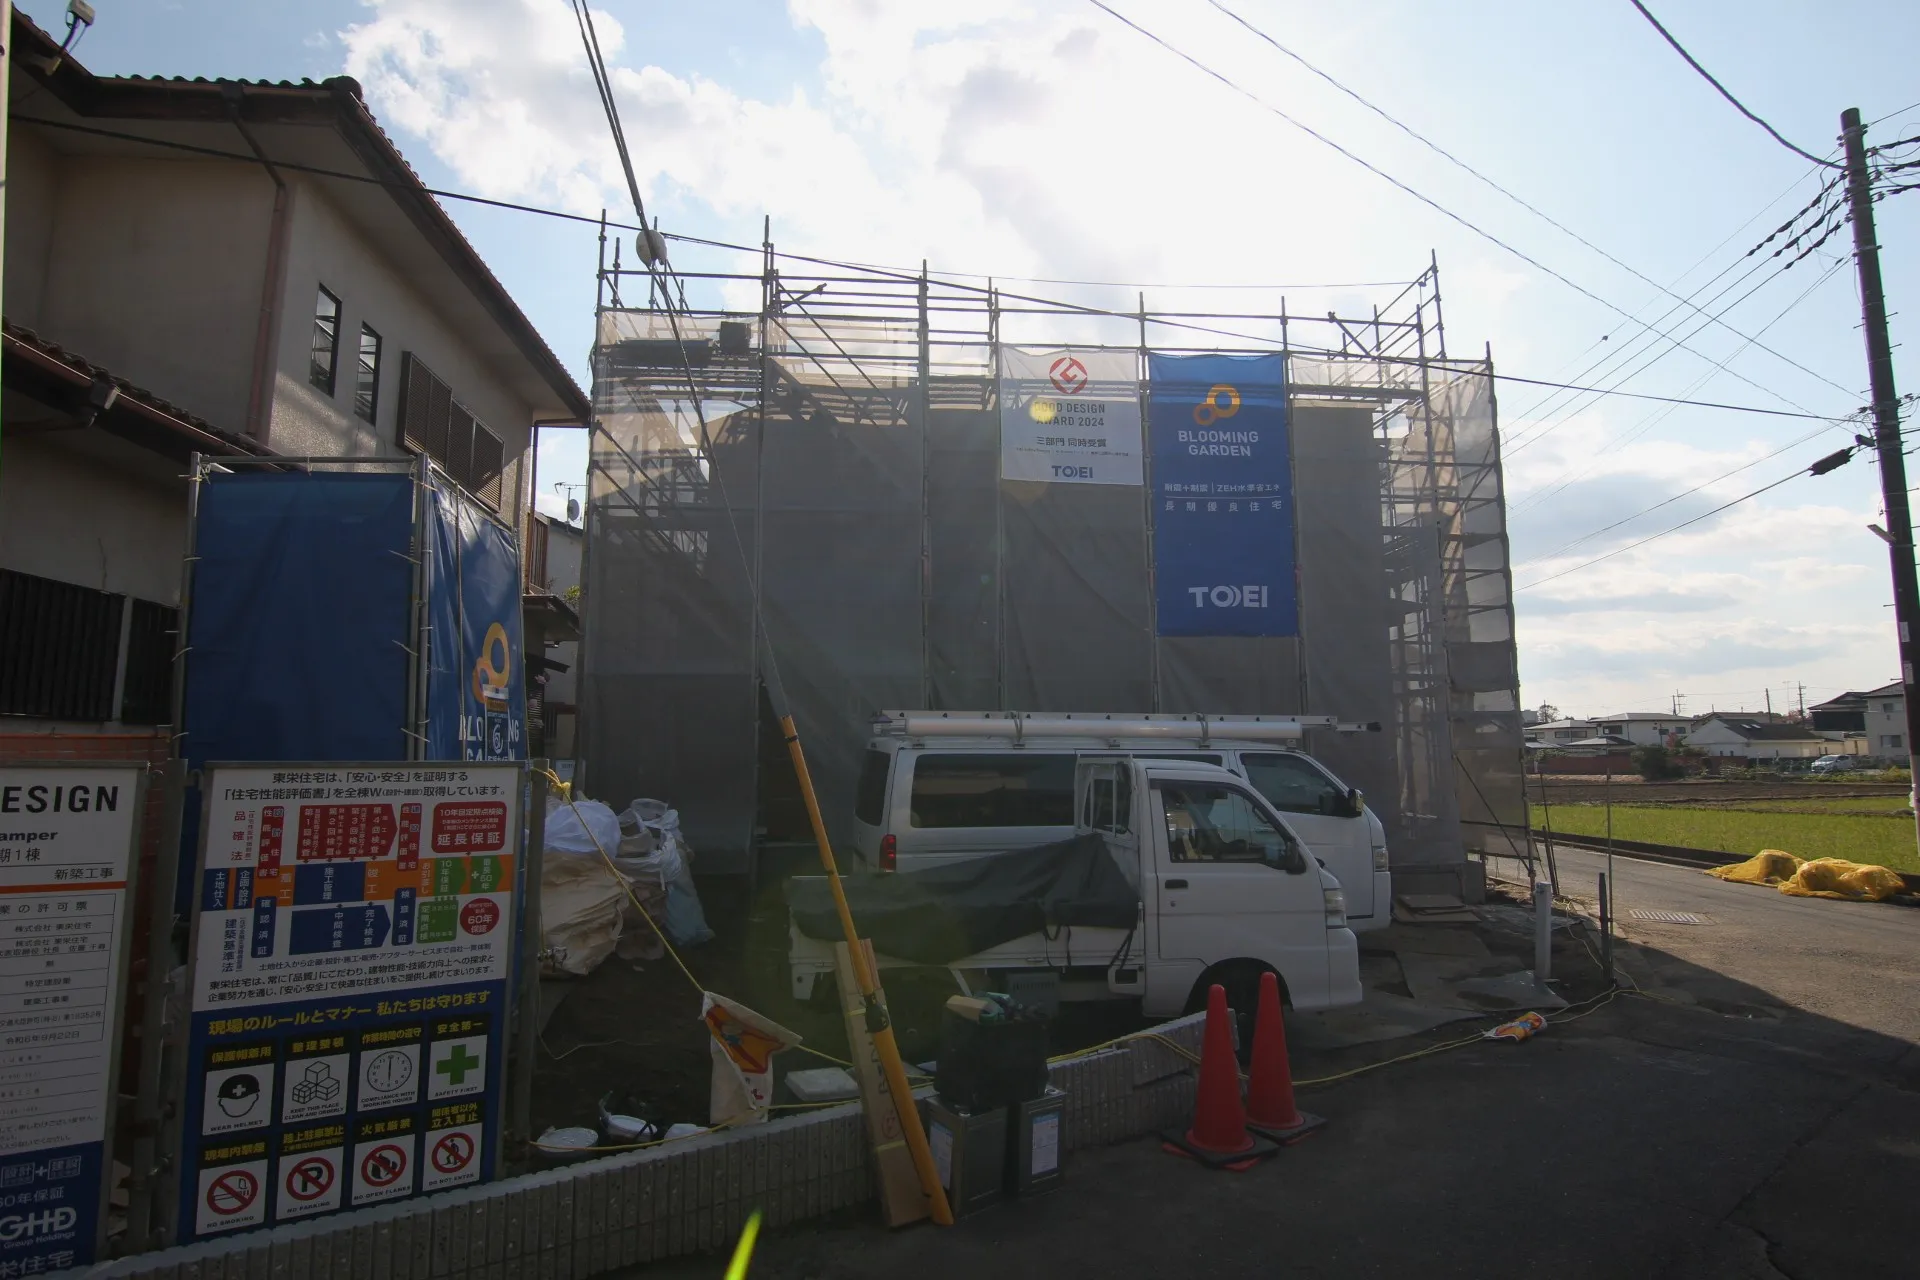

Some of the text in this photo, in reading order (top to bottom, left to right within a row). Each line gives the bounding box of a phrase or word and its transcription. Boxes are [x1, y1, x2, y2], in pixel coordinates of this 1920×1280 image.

[1066, 402, 1105, 414] DESIGN
[1036, 416, 1105, 427] AWARD 2024
[1036, 436, 1107, 448] 三部門 同時受賞
[1178, 430, 1259, 443] BLOOMING
[1188, 444, 1251, 457] GARDEN
[1051, 465, 1094, 479] TOEI
[1165, 500, 1281, 512] 長期優良住宅
[1188, 584, 1268, 608] TOEI
[1, 785, 119, 814] ESIGN
[230, 810, 246, 861] 品確法
[301, 808, 314, 856] 第1回検査
[325, 807, 338, 855] 第2回検査
[348, 807, 360, 855] 第3回検査
[371, 806, 382, 853] 第4回検査
[437, 831, 501, 846] 延長保証
[54, 867, 114, 881] 新築工事
[421, 862, 431, 894] お引渡し
[440, 860, 452, 893] 10年保証
[213, 871, 225, 908] 土地仕入
[322, 867, 334, 900] 施工管理
[398, 890, 410, 944] 検査済証
[467, 914, 493, 925] 60年
[257, 899, 271, 955] 確認済証
[332, 911, 344, 948] 中間検査
[363, 909, 375, 945] 完了検査
[222, 918, 237, 973] 建築基準法
[208, 990, 492, 1035] 現場のルールとマナー 私たちは守ります
[437, 1020, 484, 1034] 安全第一
[292, 1037, 344, 1053] 整理整頓
[434, 1089, 459, 1097] SAFETY
[363, 1099, 391, 1108] WORKING
[431, 1102, 478, 1117] 関係者以外
[233, 1120, 263, 1129] HELMET
[361, 1118, 412, 1135] 火気厳禁
[431, 1113, 478, 1128] 立入禁止
[365, 1190, 383, 1198] OPEN
[3, 1240, 34, 1249] Group
